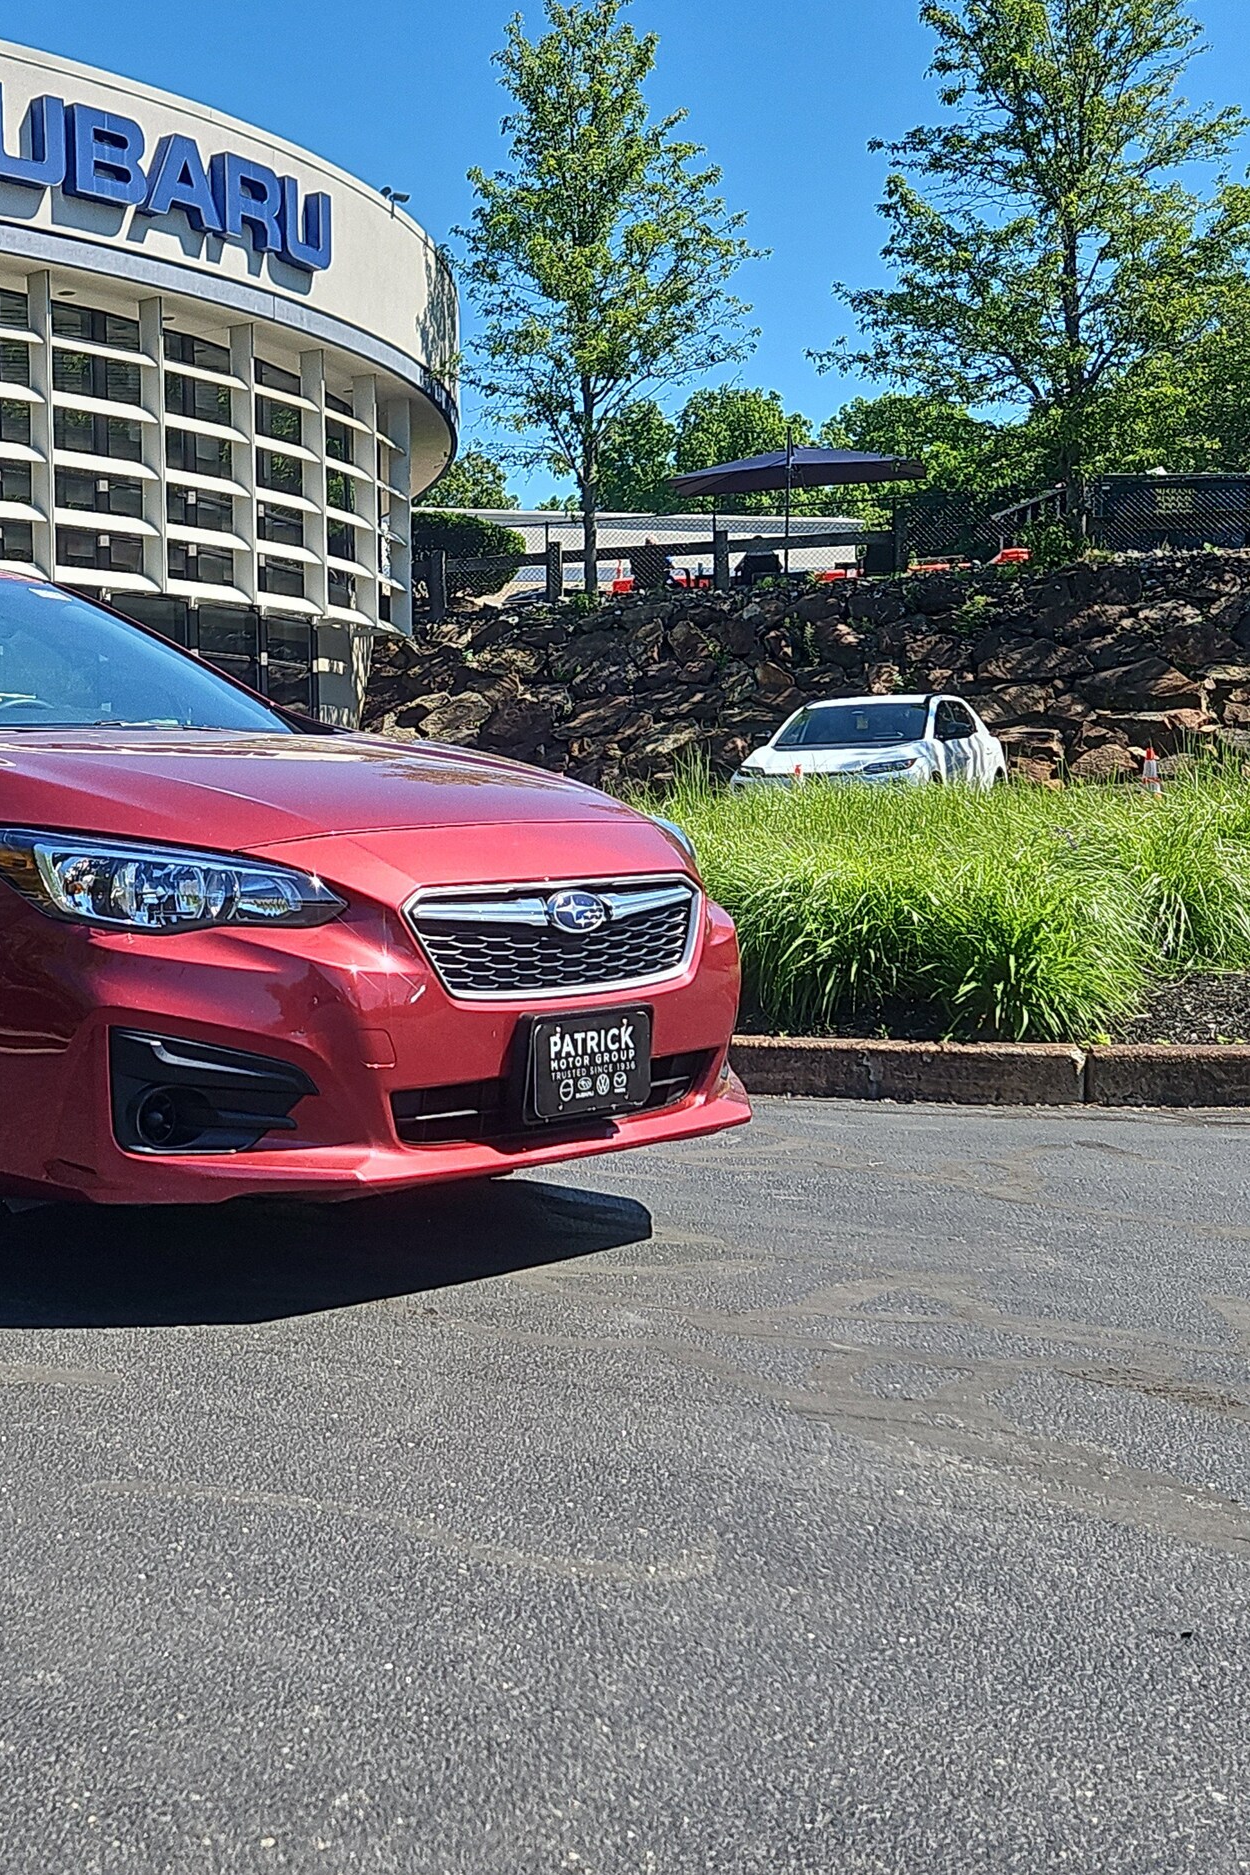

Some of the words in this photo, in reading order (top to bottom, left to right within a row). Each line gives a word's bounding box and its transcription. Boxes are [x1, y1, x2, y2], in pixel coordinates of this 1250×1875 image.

[549, 1025, 635, 1059] PATRICK
[550, 1055, 590, 1071] MOTOR
[595, 1049, 635, 1065] GROUP
[551, 1068, 587, 1080] TRUSTED
[590, 1064, 613, 1075] SINCE
